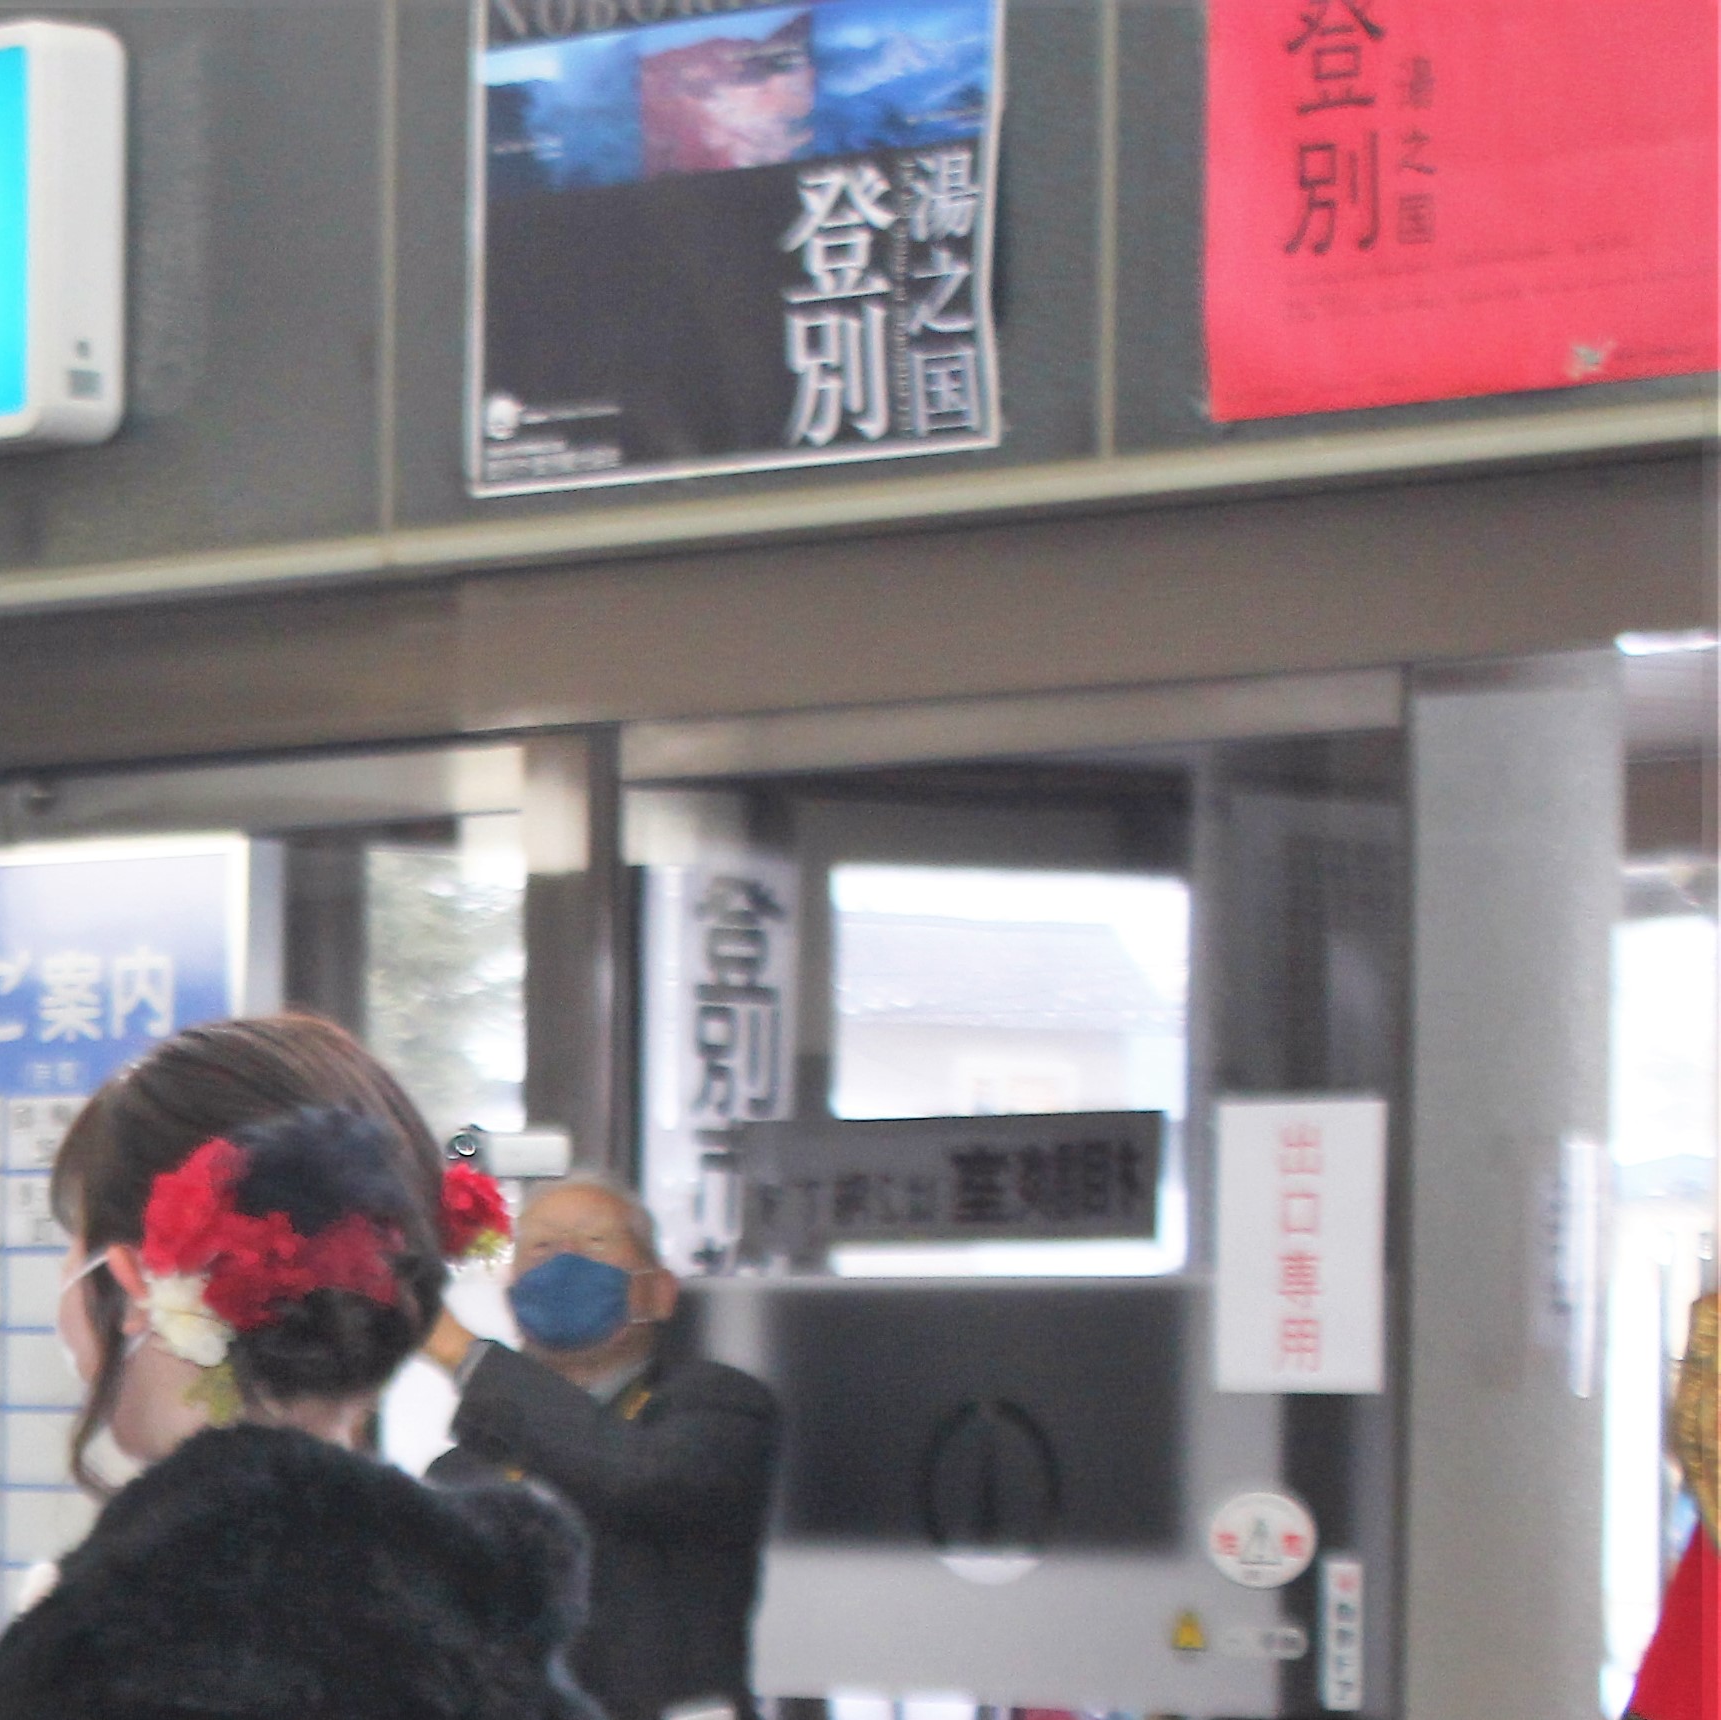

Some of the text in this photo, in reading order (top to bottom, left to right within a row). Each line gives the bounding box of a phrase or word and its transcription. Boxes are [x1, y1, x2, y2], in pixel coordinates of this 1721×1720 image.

[784, 165, 895, 449] 登別
[906, 148, 979, 438] 湯之国
[1274, 1122, 1323, 1373] 出口専用
